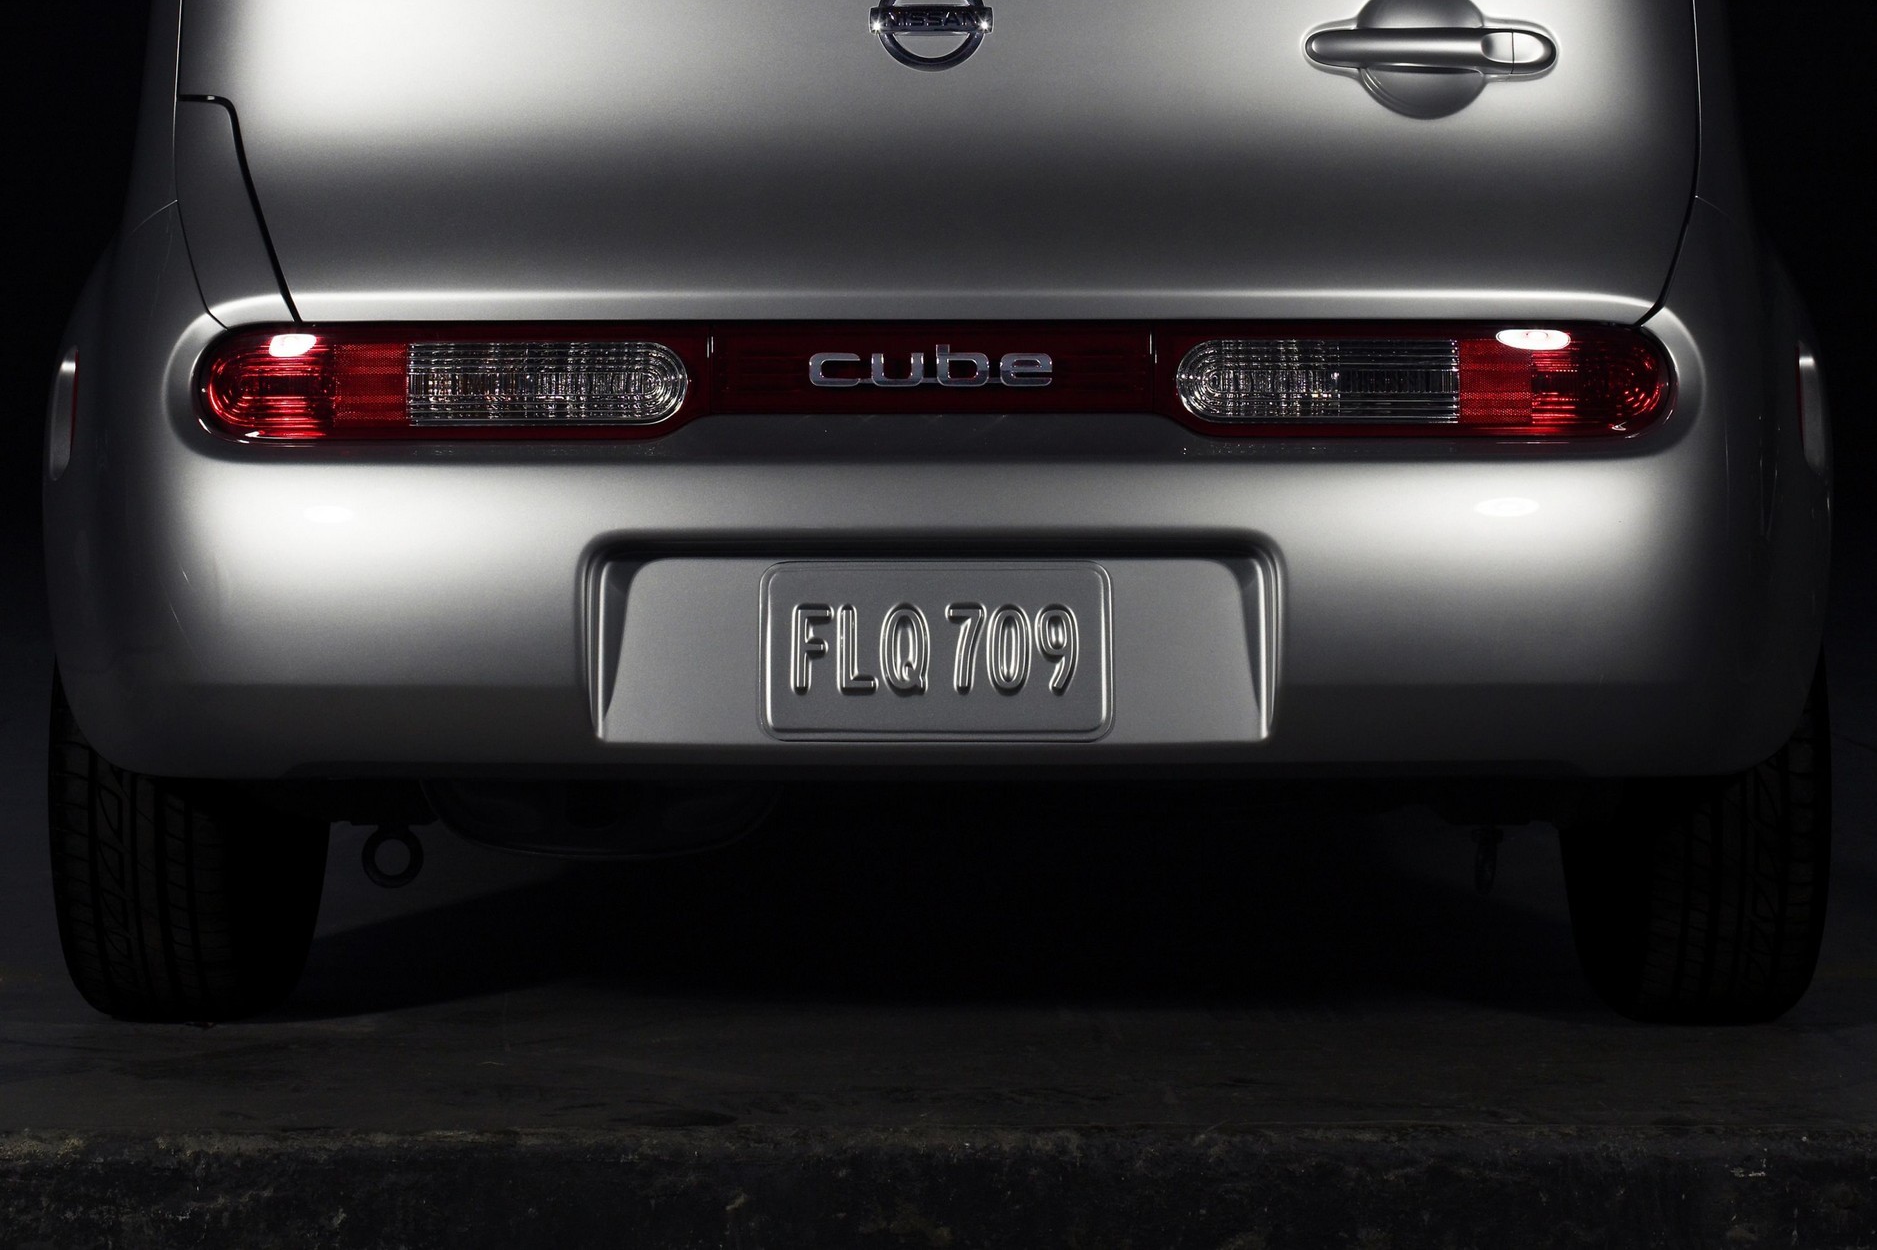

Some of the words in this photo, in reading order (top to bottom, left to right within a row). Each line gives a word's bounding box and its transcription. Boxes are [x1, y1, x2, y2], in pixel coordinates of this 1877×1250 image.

[885, 10, 978, 27] NISSAN
[808, 344, 1053, 387] cube
[790, 602, 931, 696] FLQ
[945, 602, 1079, 696] 709
